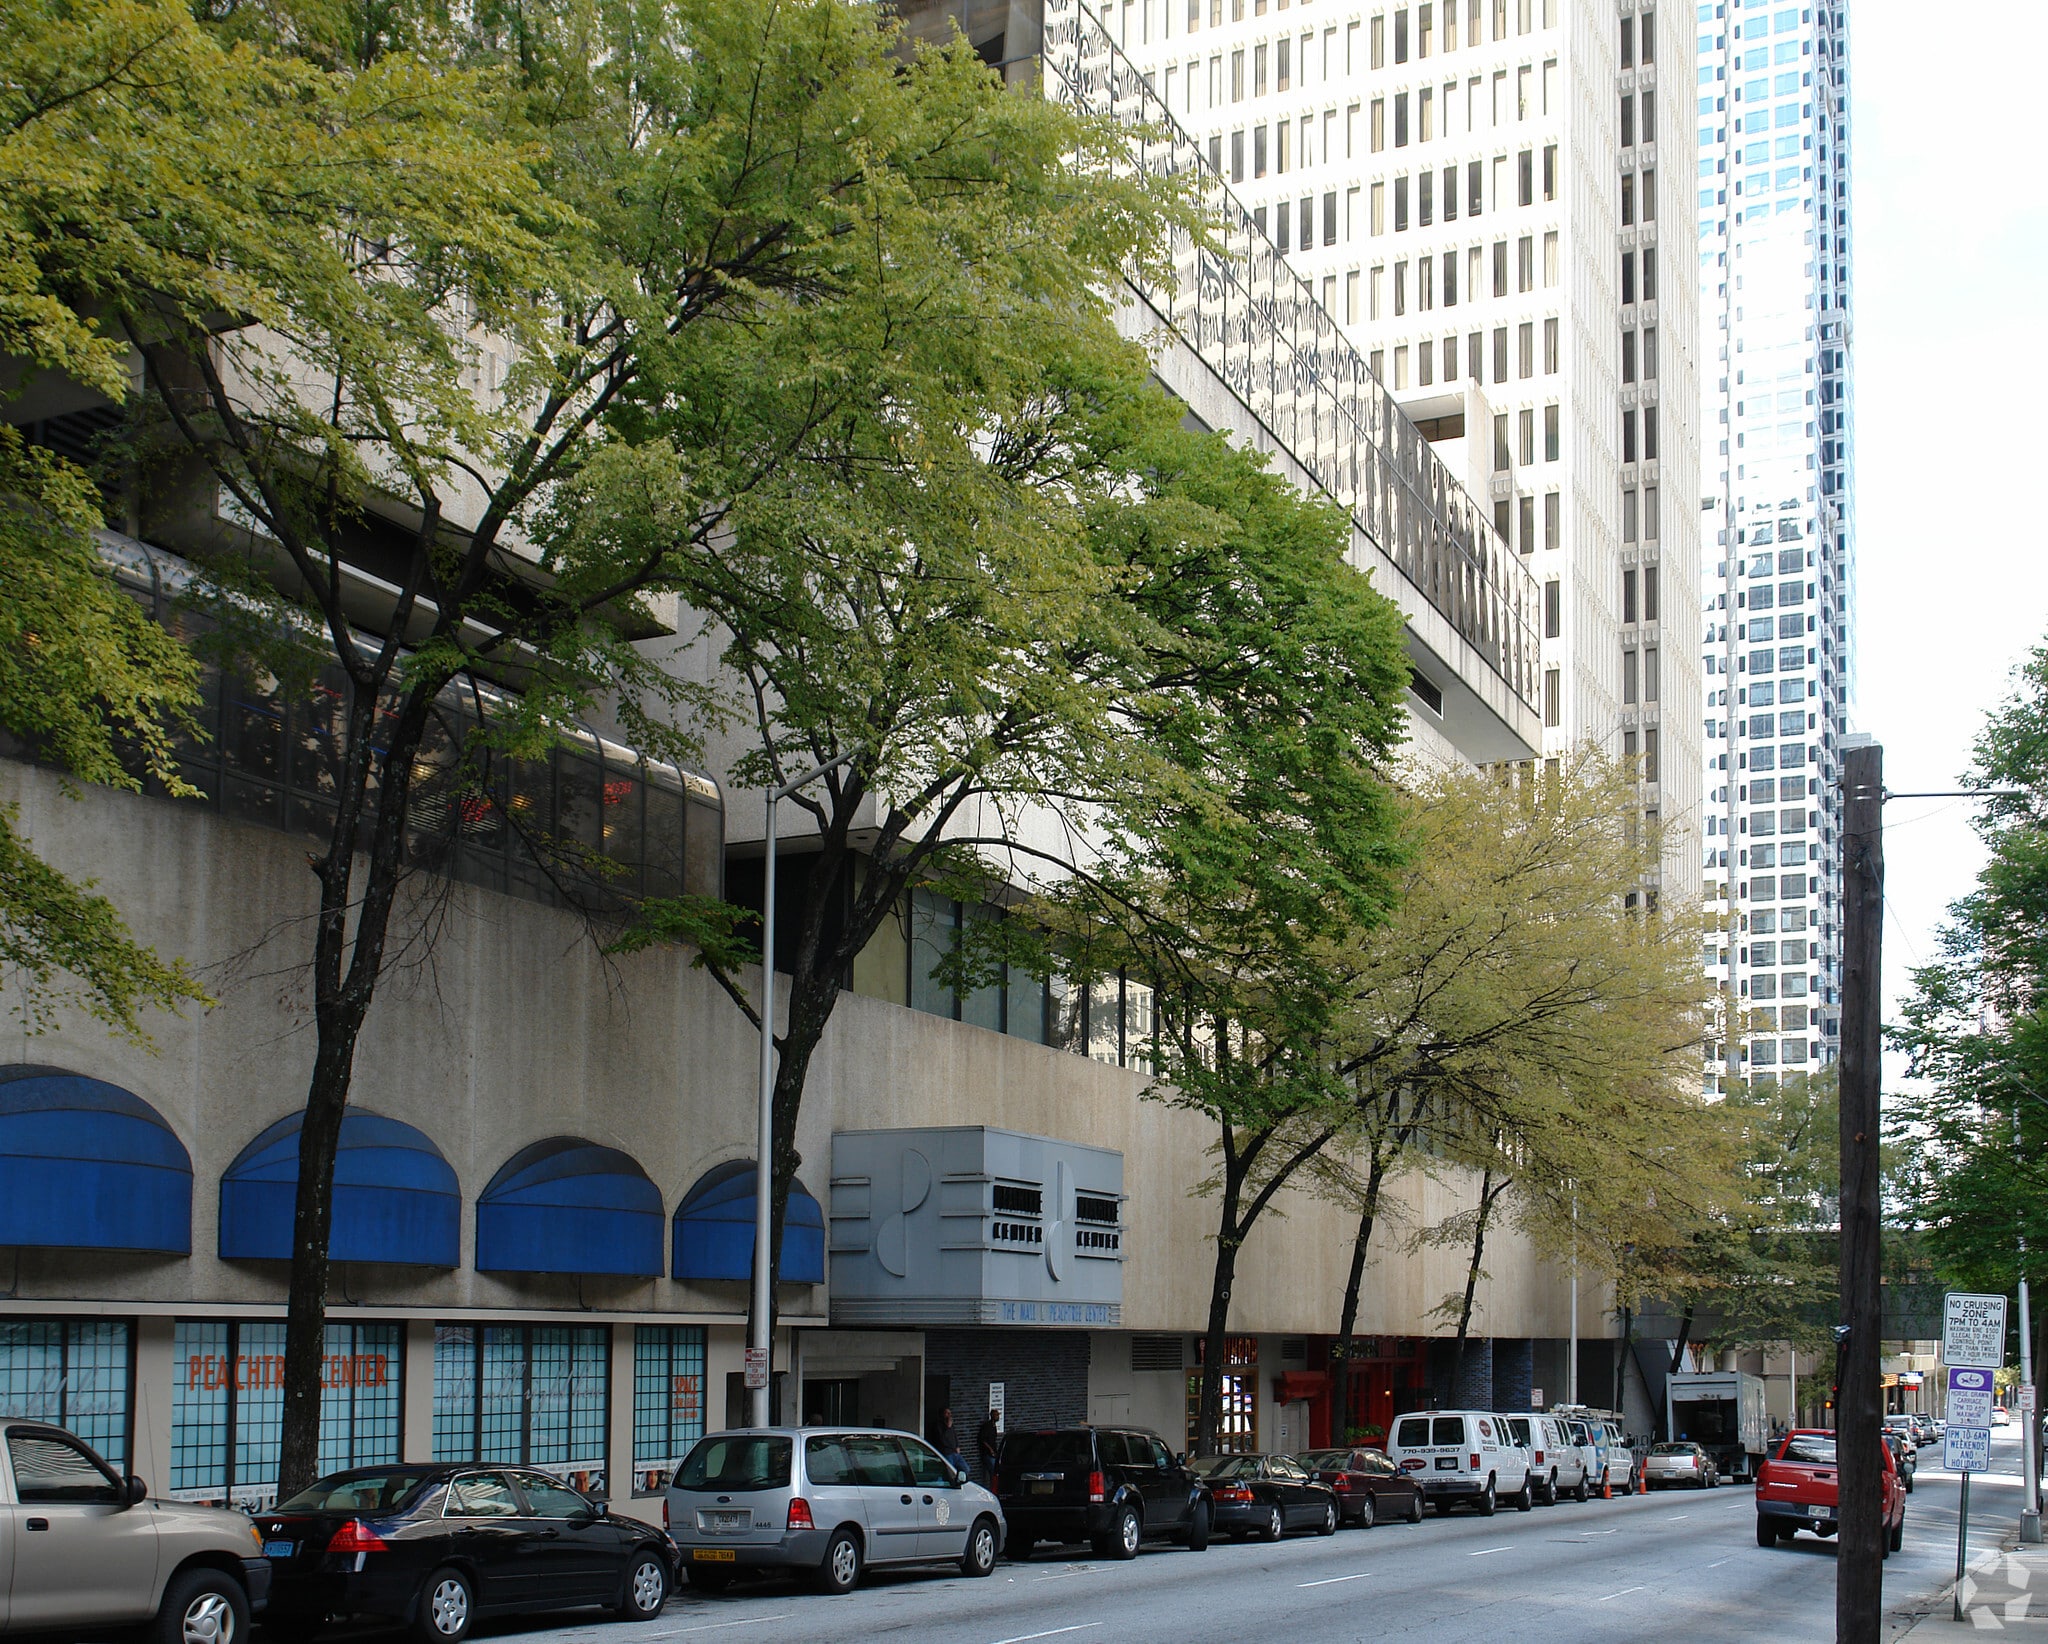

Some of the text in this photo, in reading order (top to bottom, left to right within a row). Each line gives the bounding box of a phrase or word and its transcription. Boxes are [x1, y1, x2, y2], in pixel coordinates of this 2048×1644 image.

[1949, 1300, 2002, 1311] NO CRUISING
[1002, 1302, 1108, 1322] THE MALL PEACHTREE CENTER
[1962, 1309, 1989, 1318] ZONE
[1949, 1317, 2000, 1328] 7PM TO 4AM
[320, 1353, 388, 1390] CENTER
[1963, 1430, 1970, 1439] TO
[1974, 1431, 1987, 1440] 6AM
[1950, 1440, 1985, 1450] WEEKENDS
[1960, 1450, 1974, 1459] AND
[1951, 1459, 1982, 1469] HOLIDAYS
